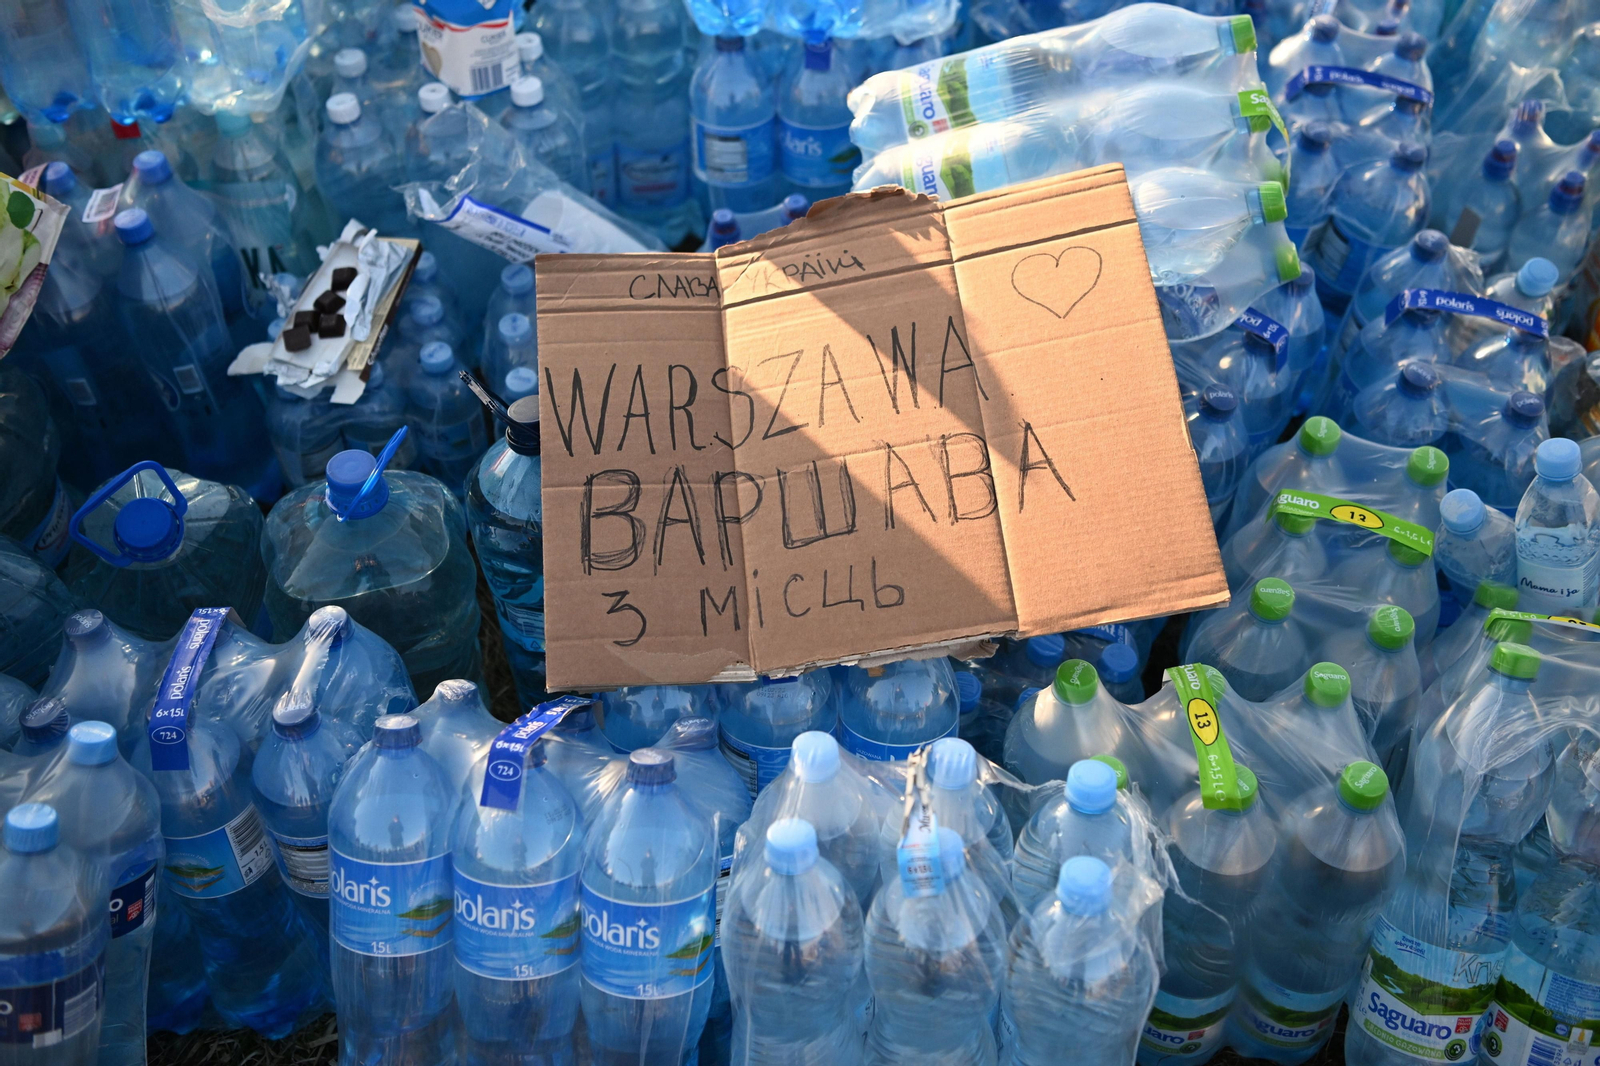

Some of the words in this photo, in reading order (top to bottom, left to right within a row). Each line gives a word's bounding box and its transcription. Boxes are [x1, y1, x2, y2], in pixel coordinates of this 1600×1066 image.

[1435, 296, 1475, 312] polaris
[1496, 309, 1533, 327] polaris
[545, 316, 990, 459] WARSZAWA
[1209, 391, 1234, 399] polaris
[580, 418, 1077, 576] ВАРШАВА
[1260, 587, 1291, 597] Saguaro
[1520, 577, 1557, 593] Mama
[189, 619, 210, 650] polaris
[170, 665, 191, 700] polaris
[1313, 670, 1347, 682] Saguaro
[1194, 711, 1211, 729] 13
[159, 731, 178, 740] 724
[514, 720, 545, 740] polaris
[497, 765, 515, 777] 724
[1354, 766, 1377, 789] Saguaro
[331, 867, 392, 908] olaris
[454, 890, 536, 931] polaris
[582, 904, 660, 950] polaris
[1367, 991, 1453, 1040] Saguaro
[1395, 1040, 1442, 1059] GAZOWANA
